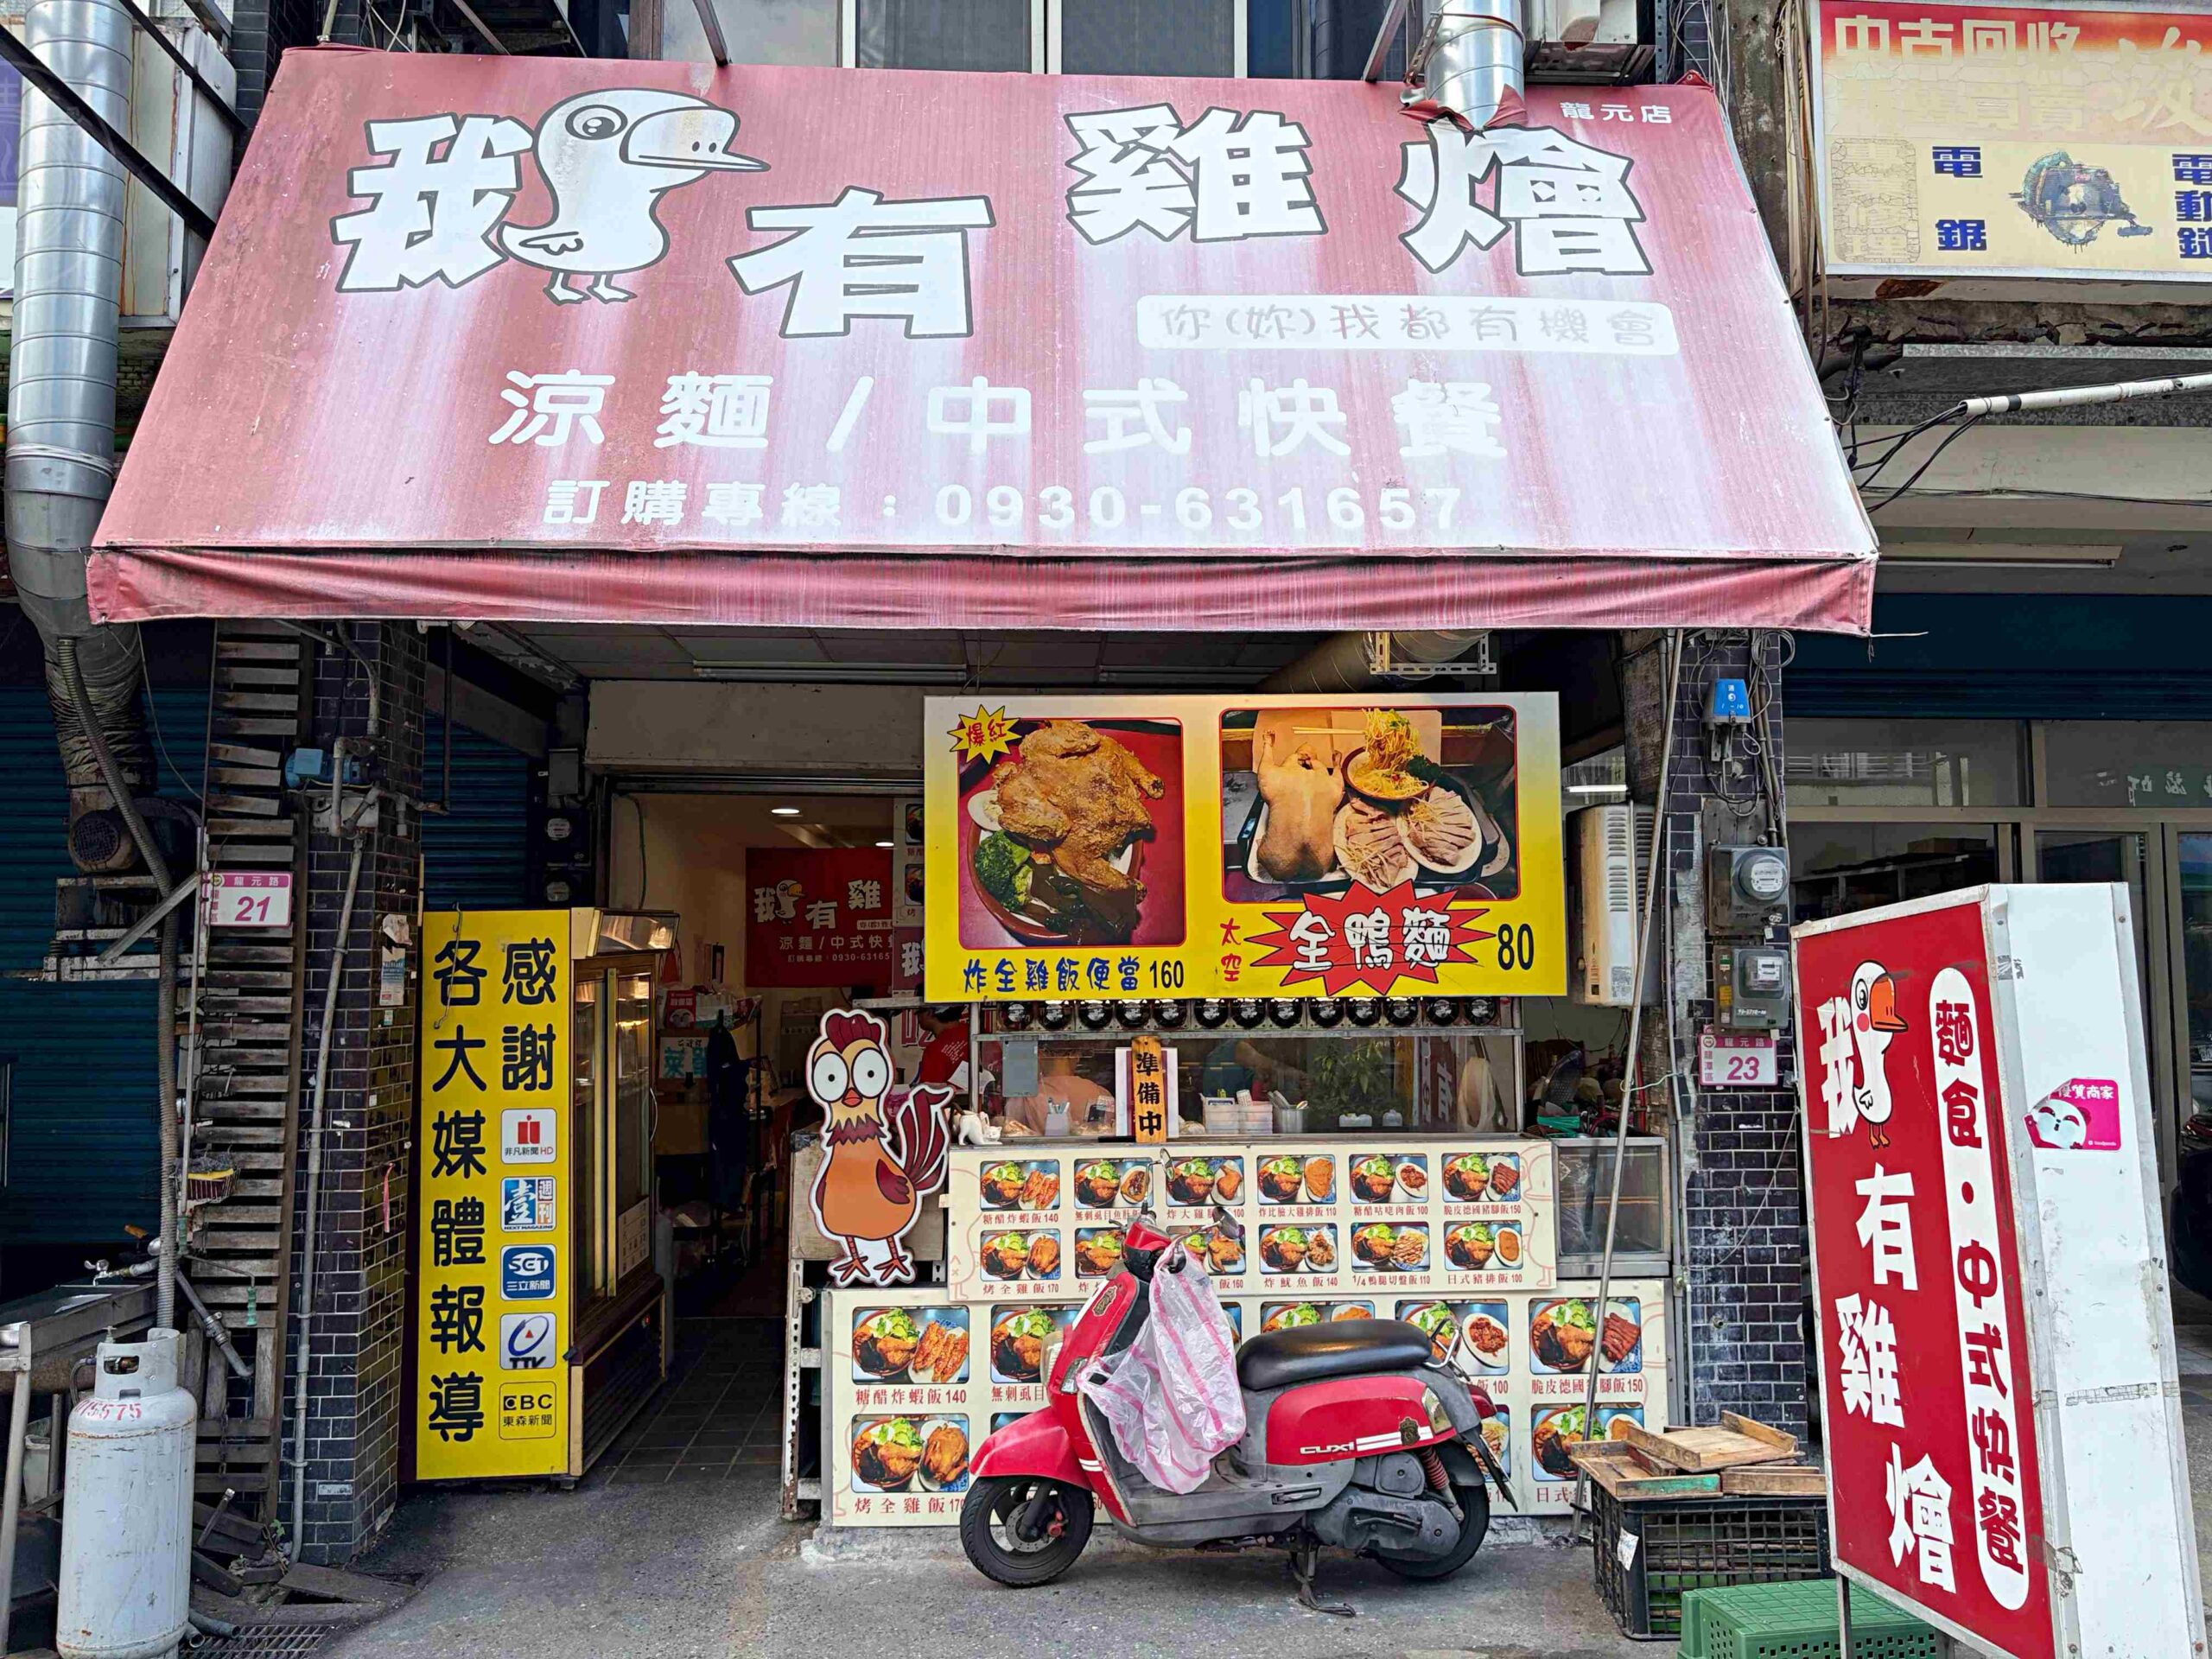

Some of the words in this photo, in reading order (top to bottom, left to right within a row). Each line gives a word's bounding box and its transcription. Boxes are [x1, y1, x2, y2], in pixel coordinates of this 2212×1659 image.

[1834, 15, 2081, 76] 中古回收
[1560, 101, 1672, 124] 龍元店
[965, 720, 1009, 747] 爆紅
[235, 896, 270, 922] 21
[779, 935, 893, 950] 涼麵/中式快
[1221, 917, 1242, 983] 太空
[1289, 905, 1451, 972] 全鴨麵
[1497, 924, 1535, 970] 80
[501, 937, 557, 1092] 感謝
[1727, 1056, 1760, 1080] 23
[1135, 1052, 1162, 1136] 準備中
[505, 1147, 539, 1156] 非凡新聞
[540, 1146, 554, 1155] HD
[429, 939, 487, 1443] 各大媒體報導
[509, 1257, 550, 1272] SET
[506, 1280, 550, 1291] 三立新聞
[509, 1356, 547, 1369] TTV
[503, 1395, 553, 1410] EBC
[503, 1414, 552, 1426] 東森新聞
